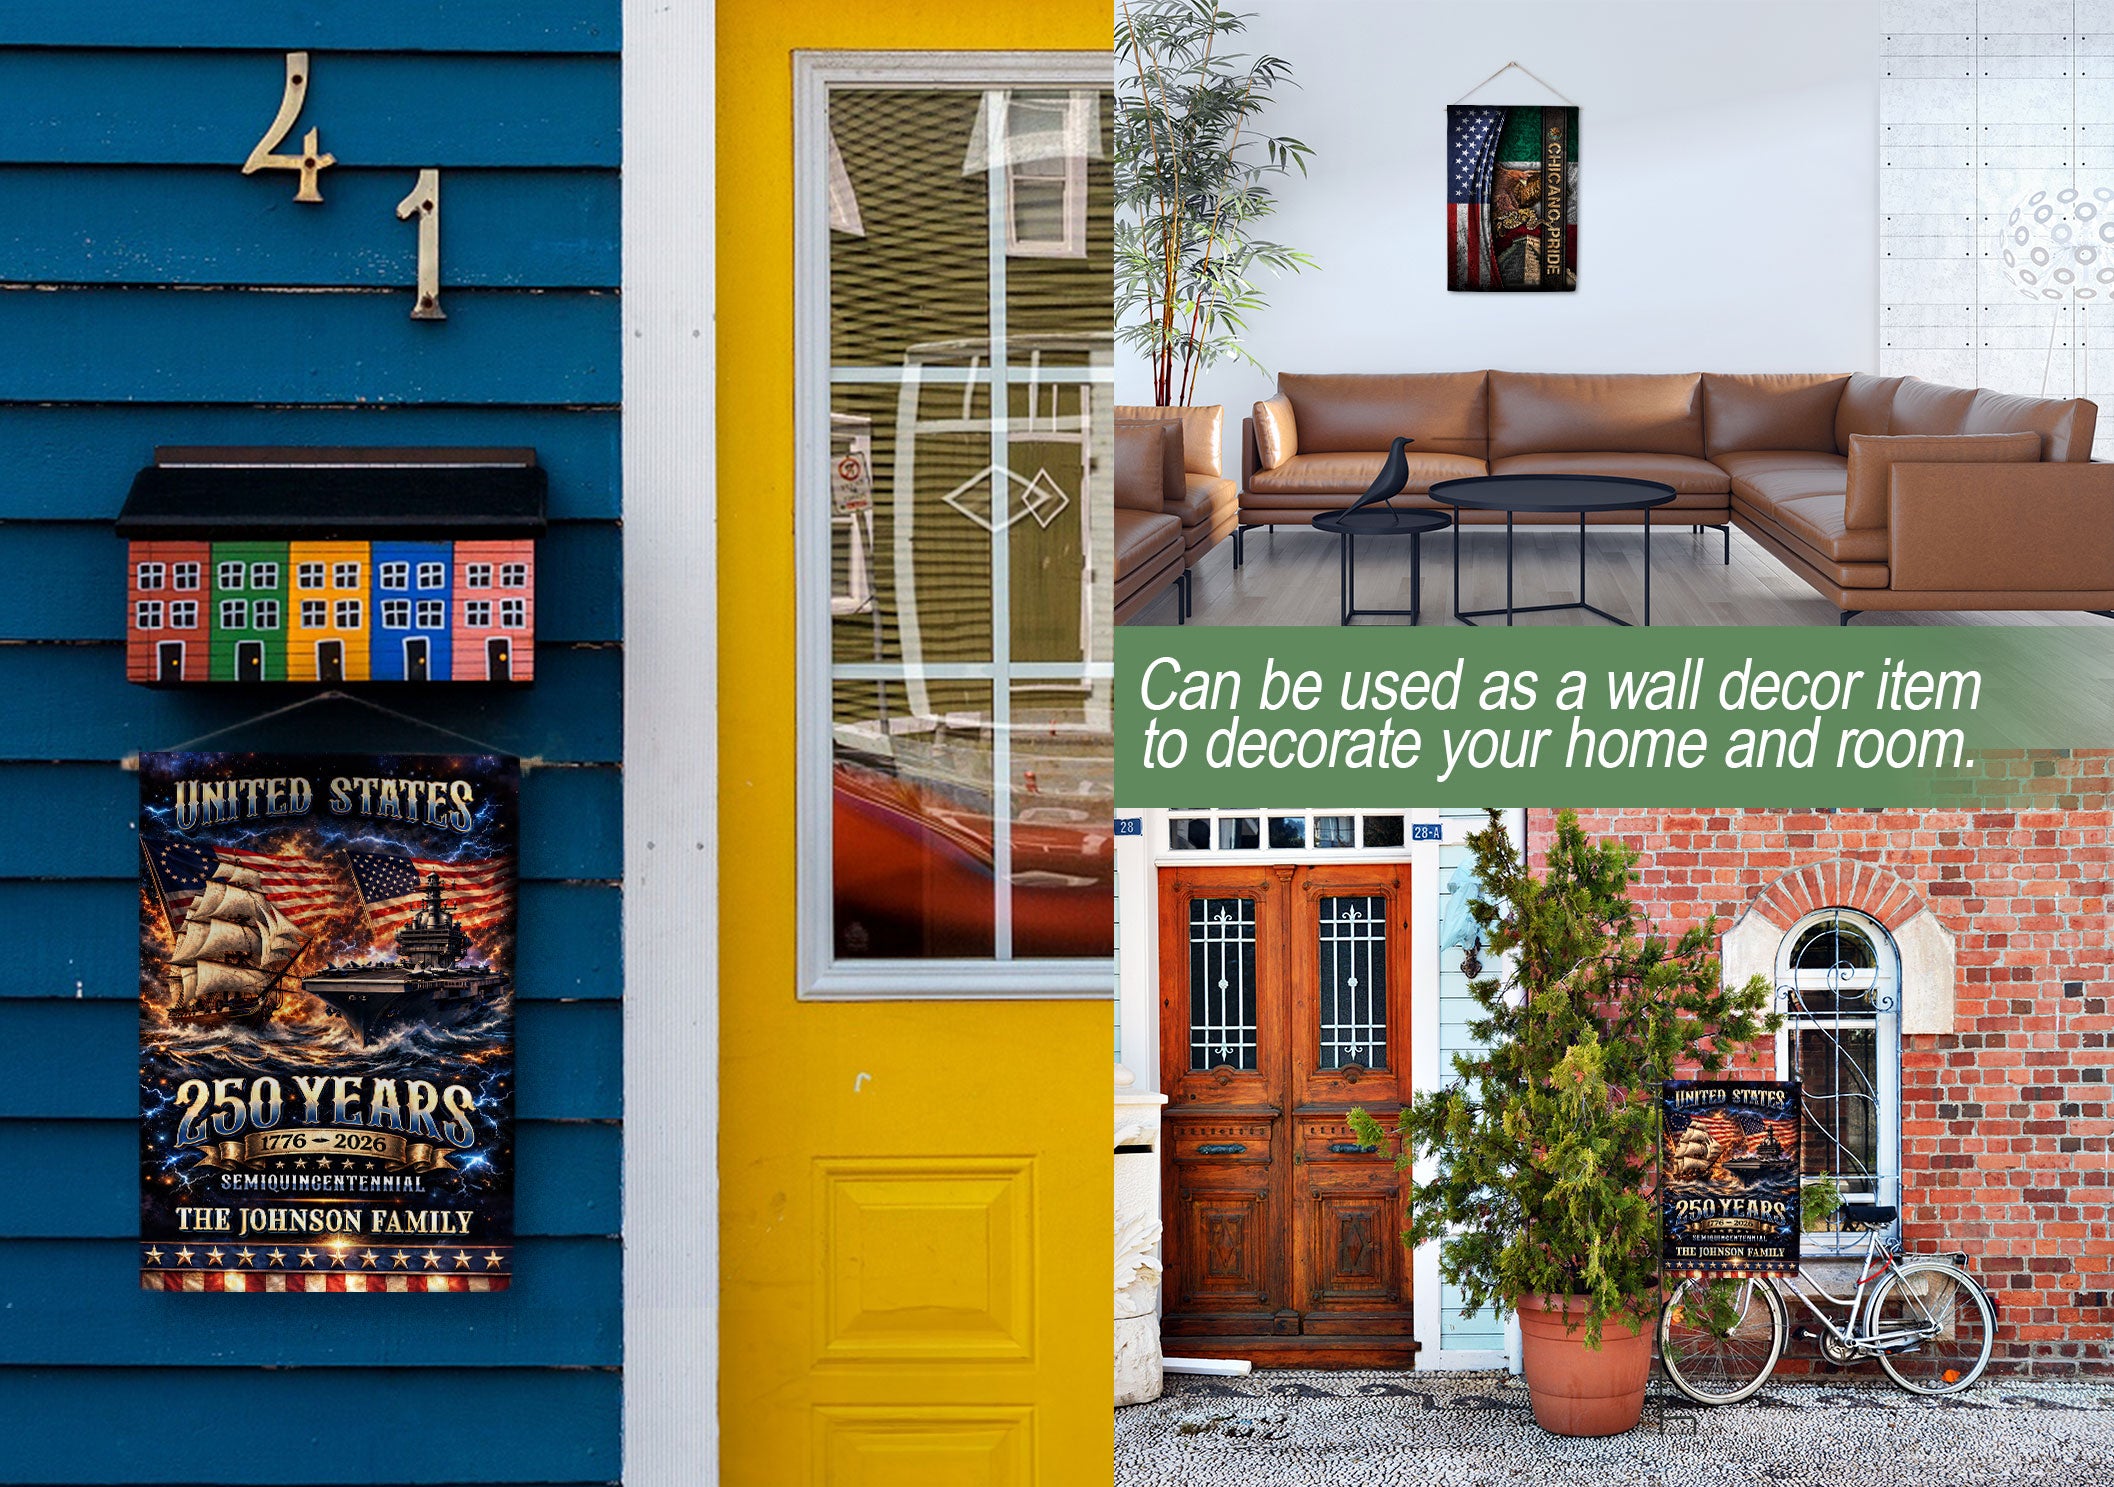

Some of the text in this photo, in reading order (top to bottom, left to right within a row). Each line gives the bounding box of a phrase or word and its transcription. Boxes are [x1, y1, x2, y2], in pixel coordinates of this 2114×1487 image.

[1547, 144, 1562, 275] CHICANO PRIDE
[174, 776, 476, 833] UNITED STATES
[1119, 821, 1134, 833] 28
[1414, 826, 1440, 839] 28-A
[1674, 1089, 1786, 1109] UNITED STATES
[174, 1076, 477, 1149] 250 YEARS
[261, 1134, 387, 1152] 1776 2026
[220, 1173, 427, 1193] SEMIQUINCENTENNIAL
[176, 1207, 474, 1236] THE JOHNSON FAMILY
[1675, 1198, 1787, 1226] 250 YEARS
[1675, 1246, 1786, 1258] THE JOHNSON FAMILY
